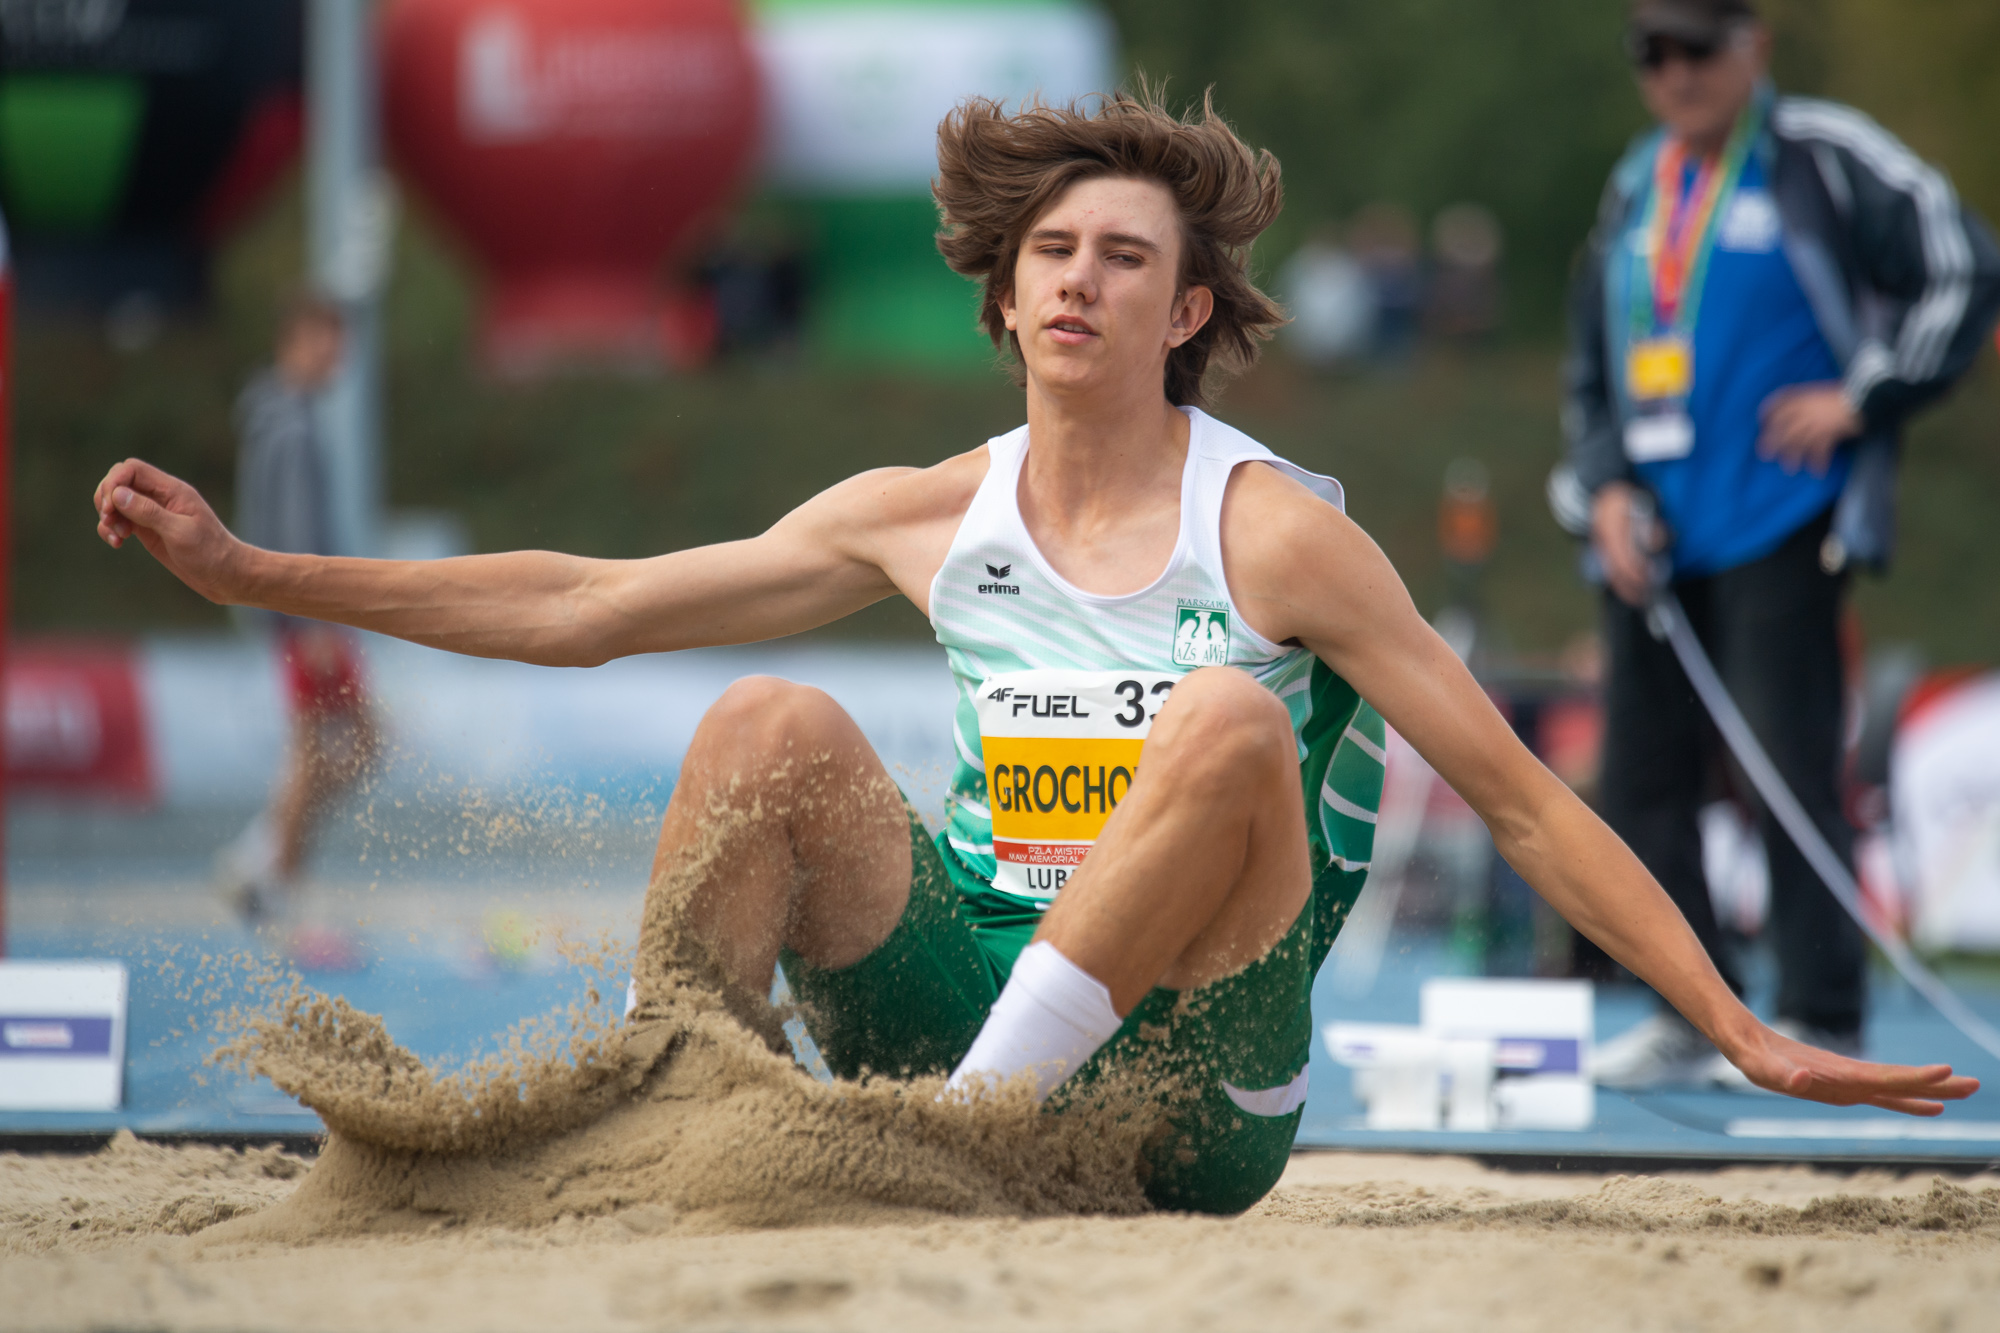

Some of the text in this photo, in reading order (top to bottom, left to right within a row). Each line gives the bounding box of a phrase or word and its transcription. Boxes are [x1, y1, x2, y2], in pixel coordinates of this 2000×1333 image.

[978, 582, 1020, 595] erima
[1177, 597, 1230, 609] WARSZAWA
[1175, 642, 1225, 664] AZS AWF
[987, 687, 1090, 718] 4F FUEL
[993, 764, 1138, 814] GROCHO
[1028, 846, 1052, 855] PZLA
[1029, 854, 1081, 864] MEMORIAŁ
[1027, 867, 1075, 890] LUB
